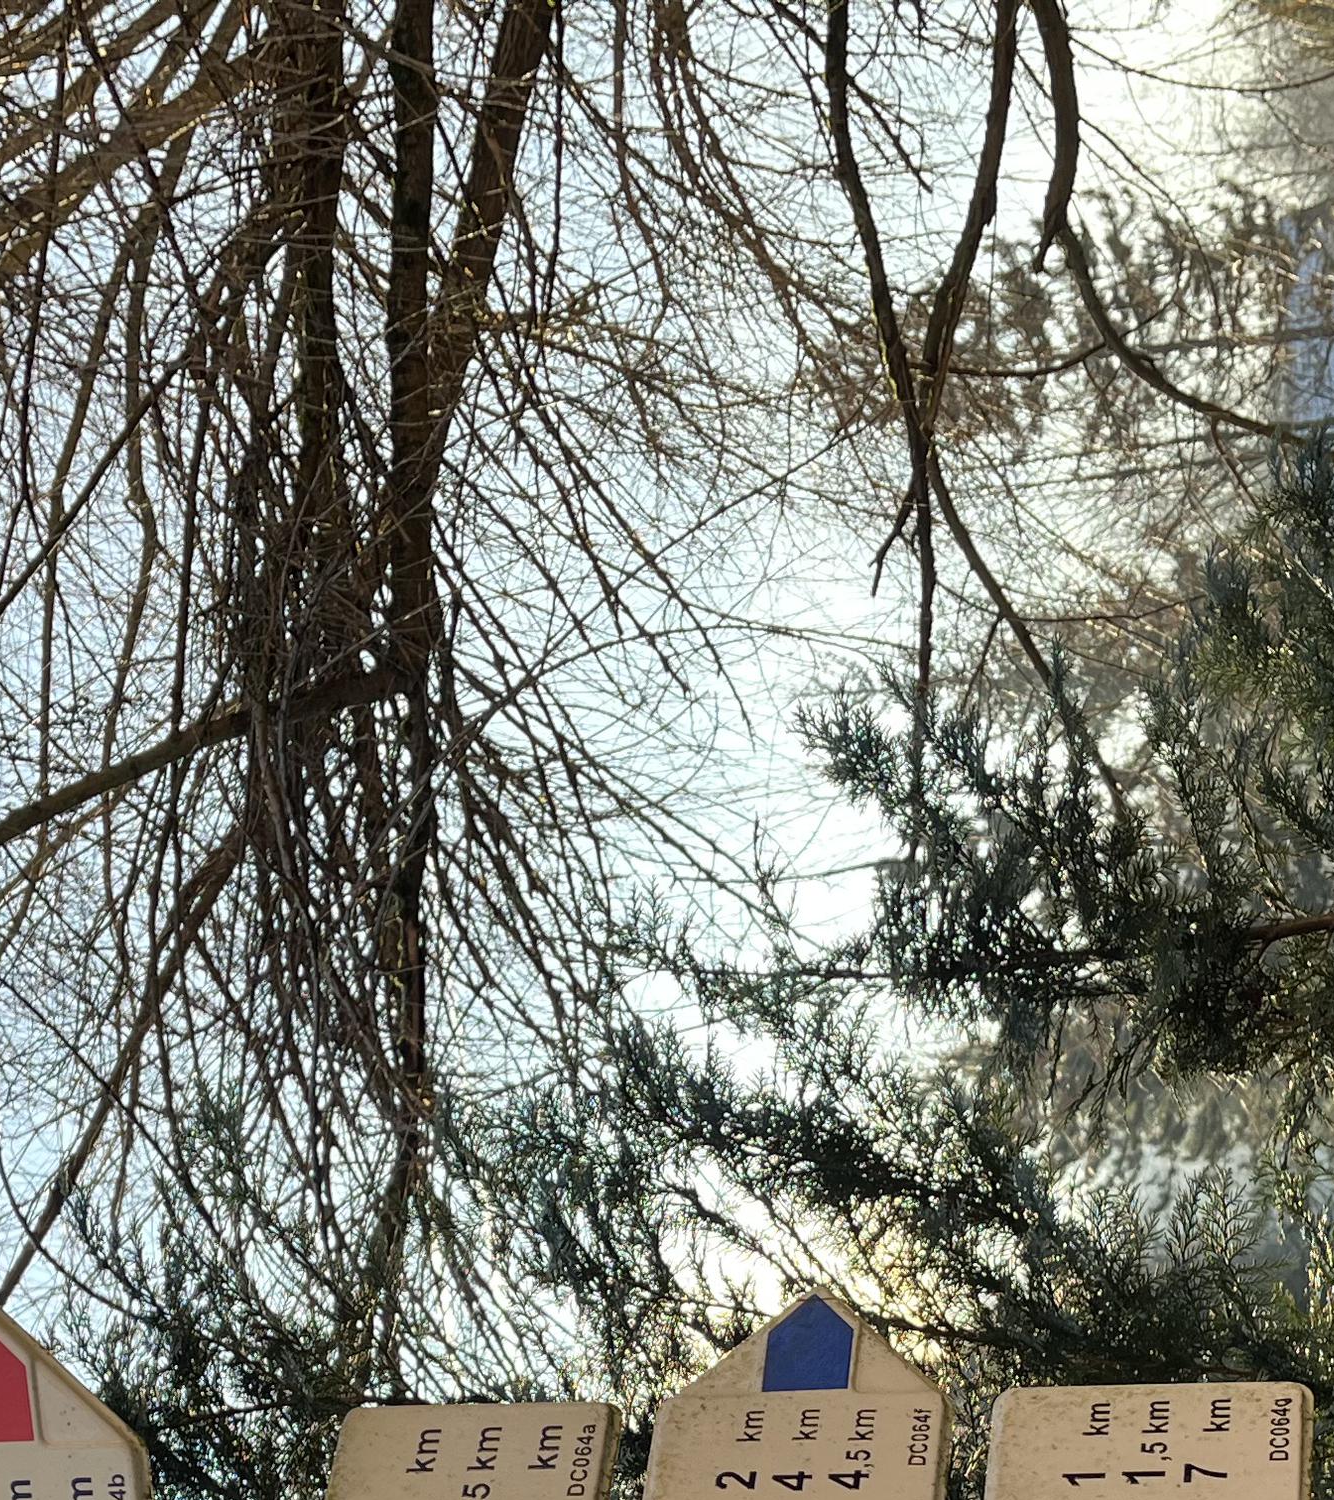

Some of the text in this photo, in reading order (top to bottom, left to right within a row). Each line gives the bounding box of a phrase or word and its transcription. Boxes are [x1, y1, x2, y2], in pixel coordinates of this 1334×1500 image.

[406, 1429, 442, 1473] km
[467, 1426, 503, 1471] km
[528, 1425, 563, 1470] km
[568, 1423, 597, 1497] DC064a
[715, 1409, 766, 1490] 2 km
[772, 1408, 821, 1491] 4 km
[828, 1408, 877, 1490] 4,5 km
[907, 1408, 932, 1466] DC064f
[1062, 1401, 1112, 1487] 1 km
[1121, 1400, 1173, 1485] 1,5 km
[1183, 1398, 1232, 1483] 7 km
